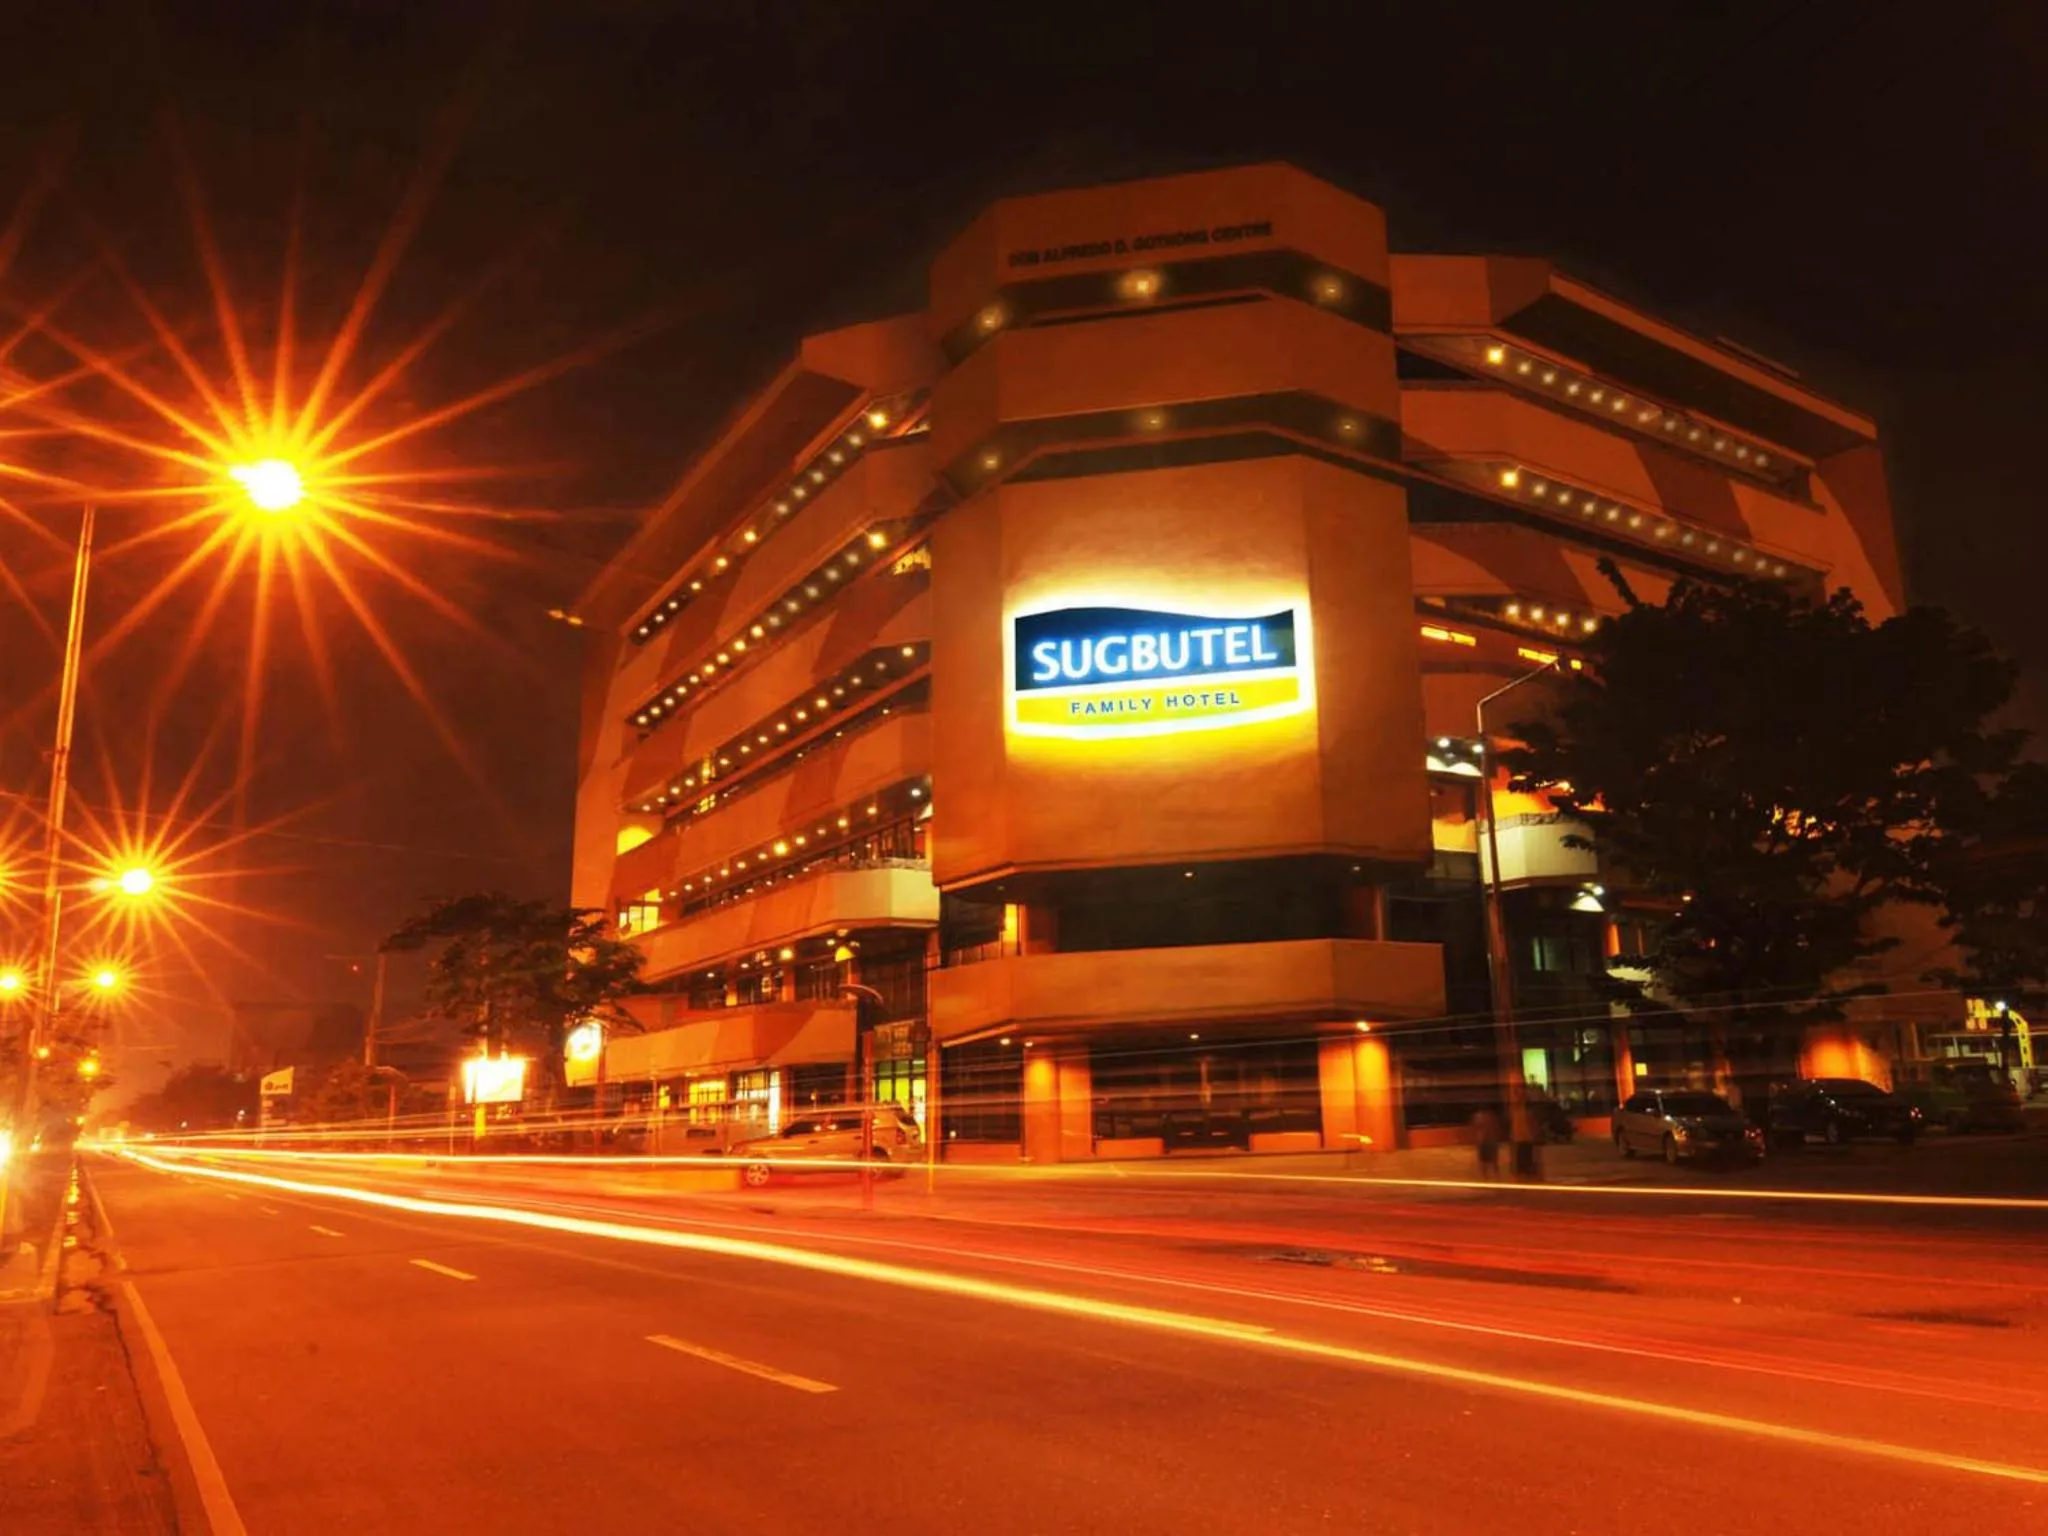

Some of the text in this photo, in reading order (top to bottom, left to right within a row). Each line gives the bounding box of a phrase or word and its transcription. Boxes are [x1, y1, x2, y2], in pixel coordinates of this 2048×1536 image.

[1032, 624, 1278, 682] SUGBUTEL
[1071, 691, 1241, 715] FAMILY HOTEL
